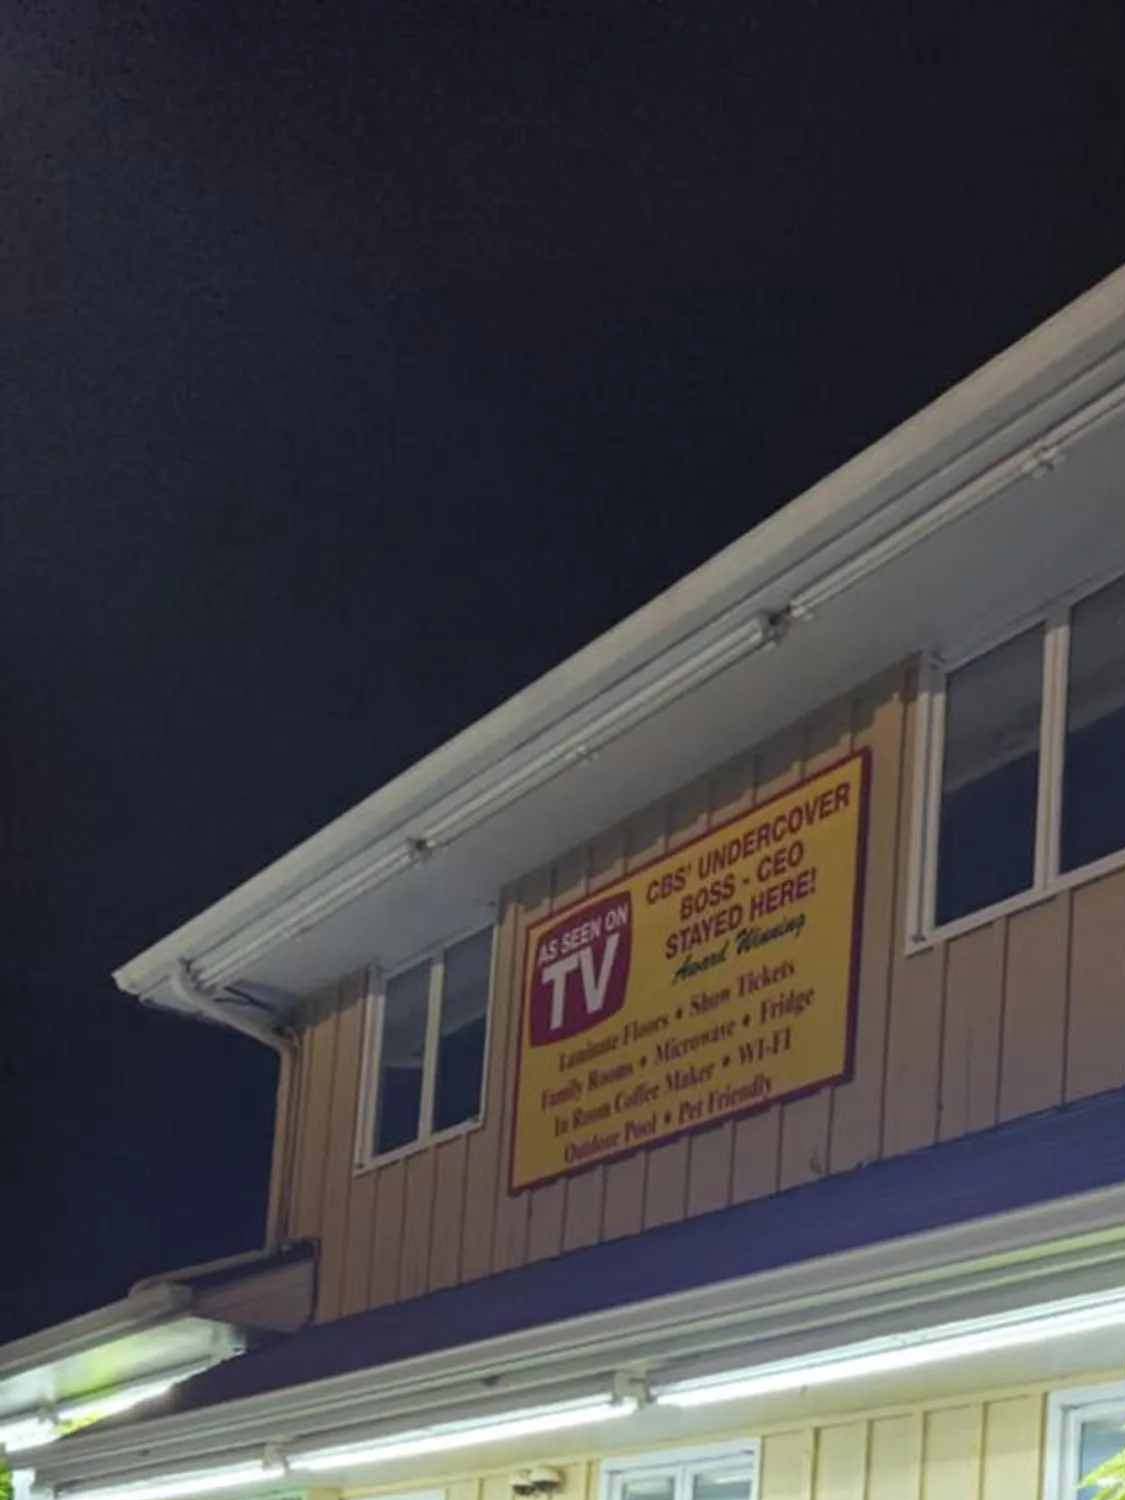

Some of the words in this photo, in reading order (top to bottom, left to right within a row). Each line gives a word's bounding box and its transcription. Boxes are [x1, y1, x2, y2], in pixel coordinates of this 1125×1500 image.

[698, 782, 850, 880] UNDERCOVER
[665, 904, 743, 960] STAYED
[751, 868, 817, 922] HERE!
[680, 873, 736, 920] BOSS
[757, 840, 804, 883] CEO
[538, 938, 558, 967] AS
[561, 916, 602, 954] SEEN
[605, 903, 628, 931] ON
[542, 933, 620, 1030] TV
[672, 939, 730, 986] Award
[736, 913, 806, 955] Winning
[541, 1078, 582, 1111] Family
[588, 1063, 633, 1092] Rooms
[655, 1019, 736, 1065] Microwave
[760, 987, 815, 1025] Fridge
[559, 1036, 618, 1073] Laminate
[623, 1015, 669, 1045] Floors
[690, 988, 731, 1017] Show
[737, 960, 796, 996] Tickets
[564, 1132, 621, 1163] Outdoor
[624, 1112, 657, 1143] Pool
[679, 1099, 703, 1124] Pet
[707, 1072, 772, 1115] Friendly
[573, 1103, 611, 1130] Room
[614, 1082, 660, 1113] Coffee
[665, 1063, 716, 1092] Maker
[739, 1025, 791, 1063] WI-FI
